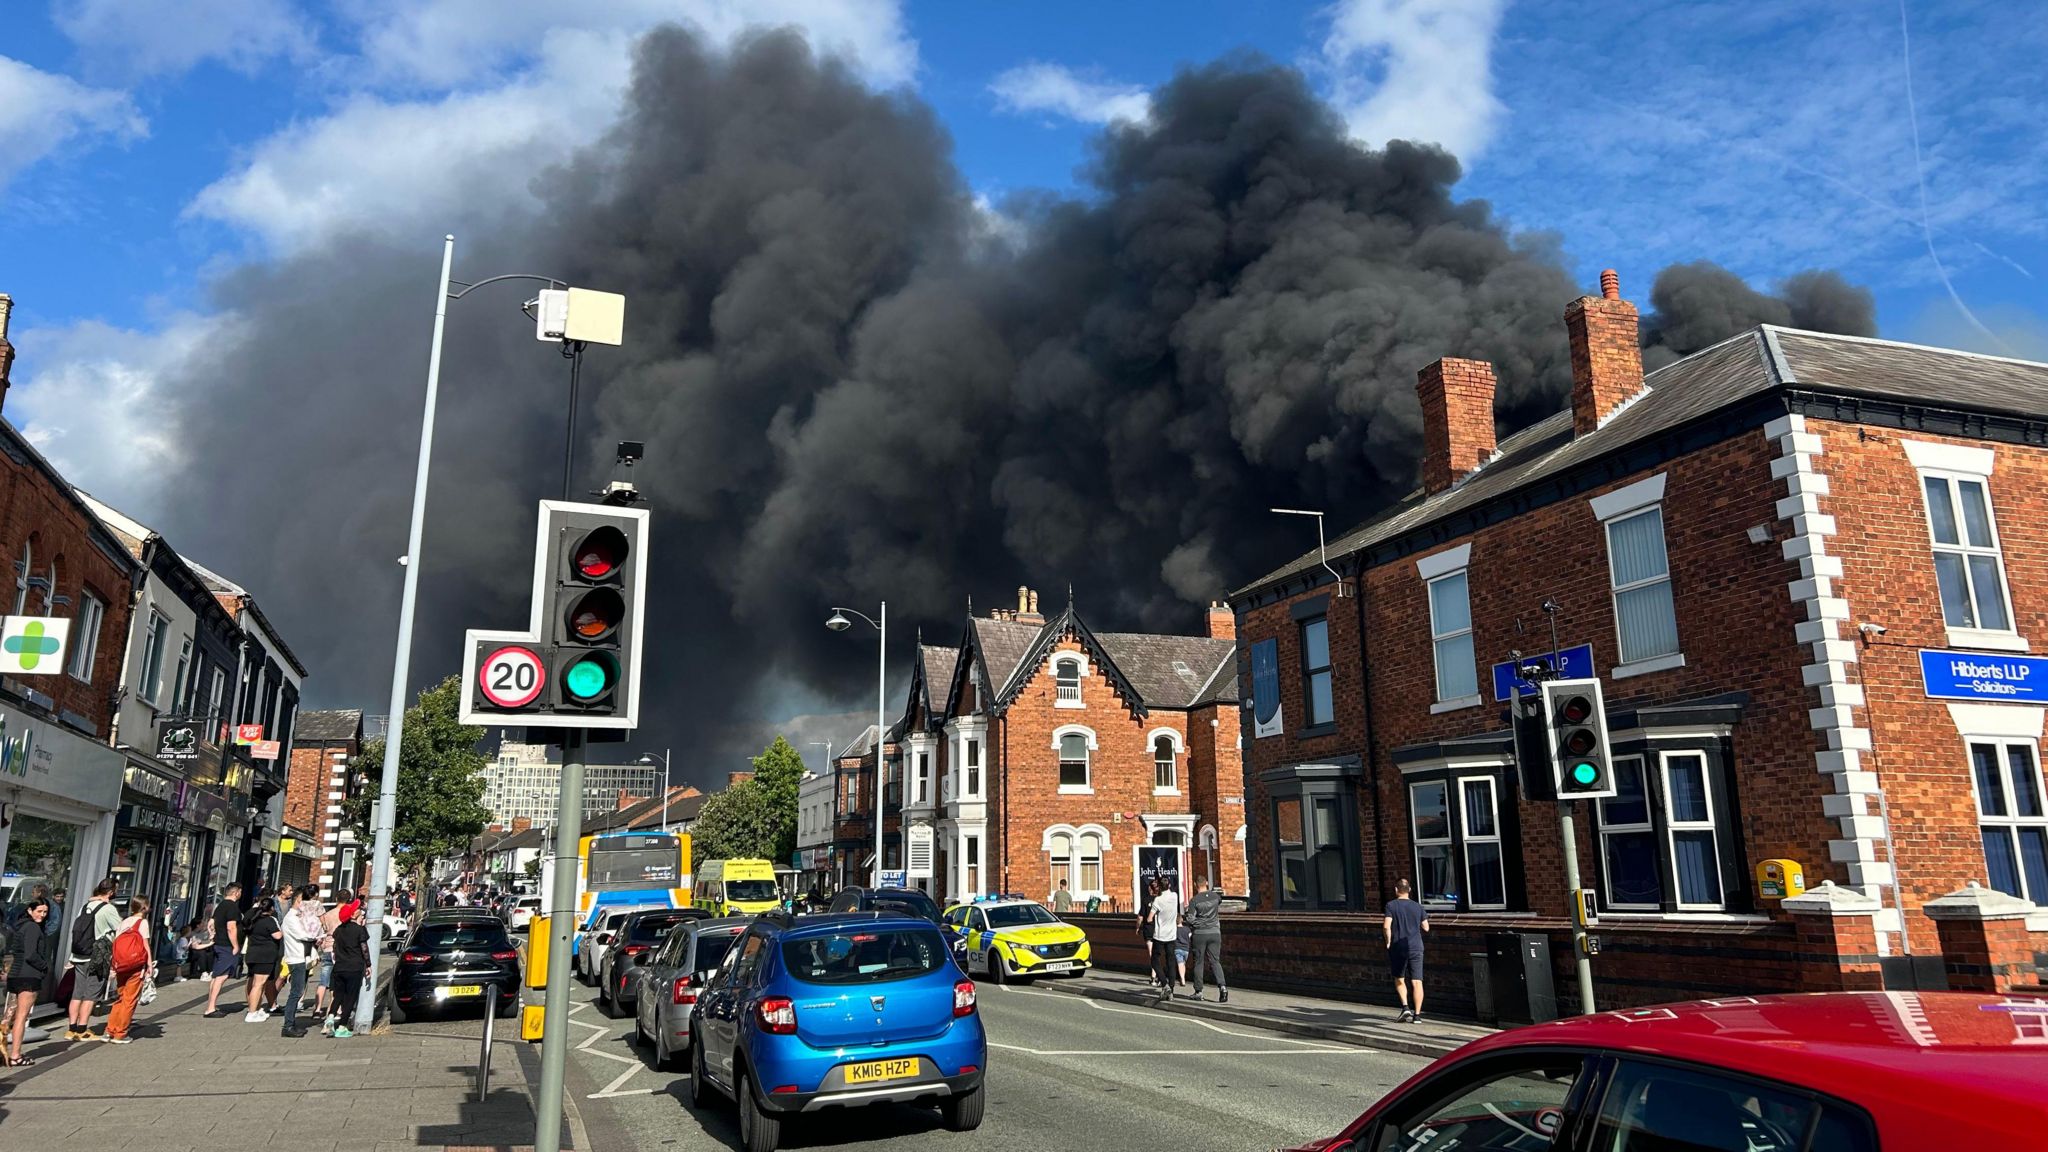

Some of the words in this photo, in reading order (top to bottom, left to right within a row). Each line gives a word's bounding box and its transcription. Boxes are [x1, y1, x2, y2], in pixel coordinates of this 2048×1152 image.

[492, 662, 535, 690] 20
[1950, 661, 2003, 679] Hibberts
[2004, 664, 2030, 680] LLP
[1972, 680, 2016, 695] Solicitors
[140, 808, 155, 827] SAME
[155, 812, 166, 830] DAY
[853, 1064, 882, 1080] KM16
[886, 1060, 911, 1076] HZP
